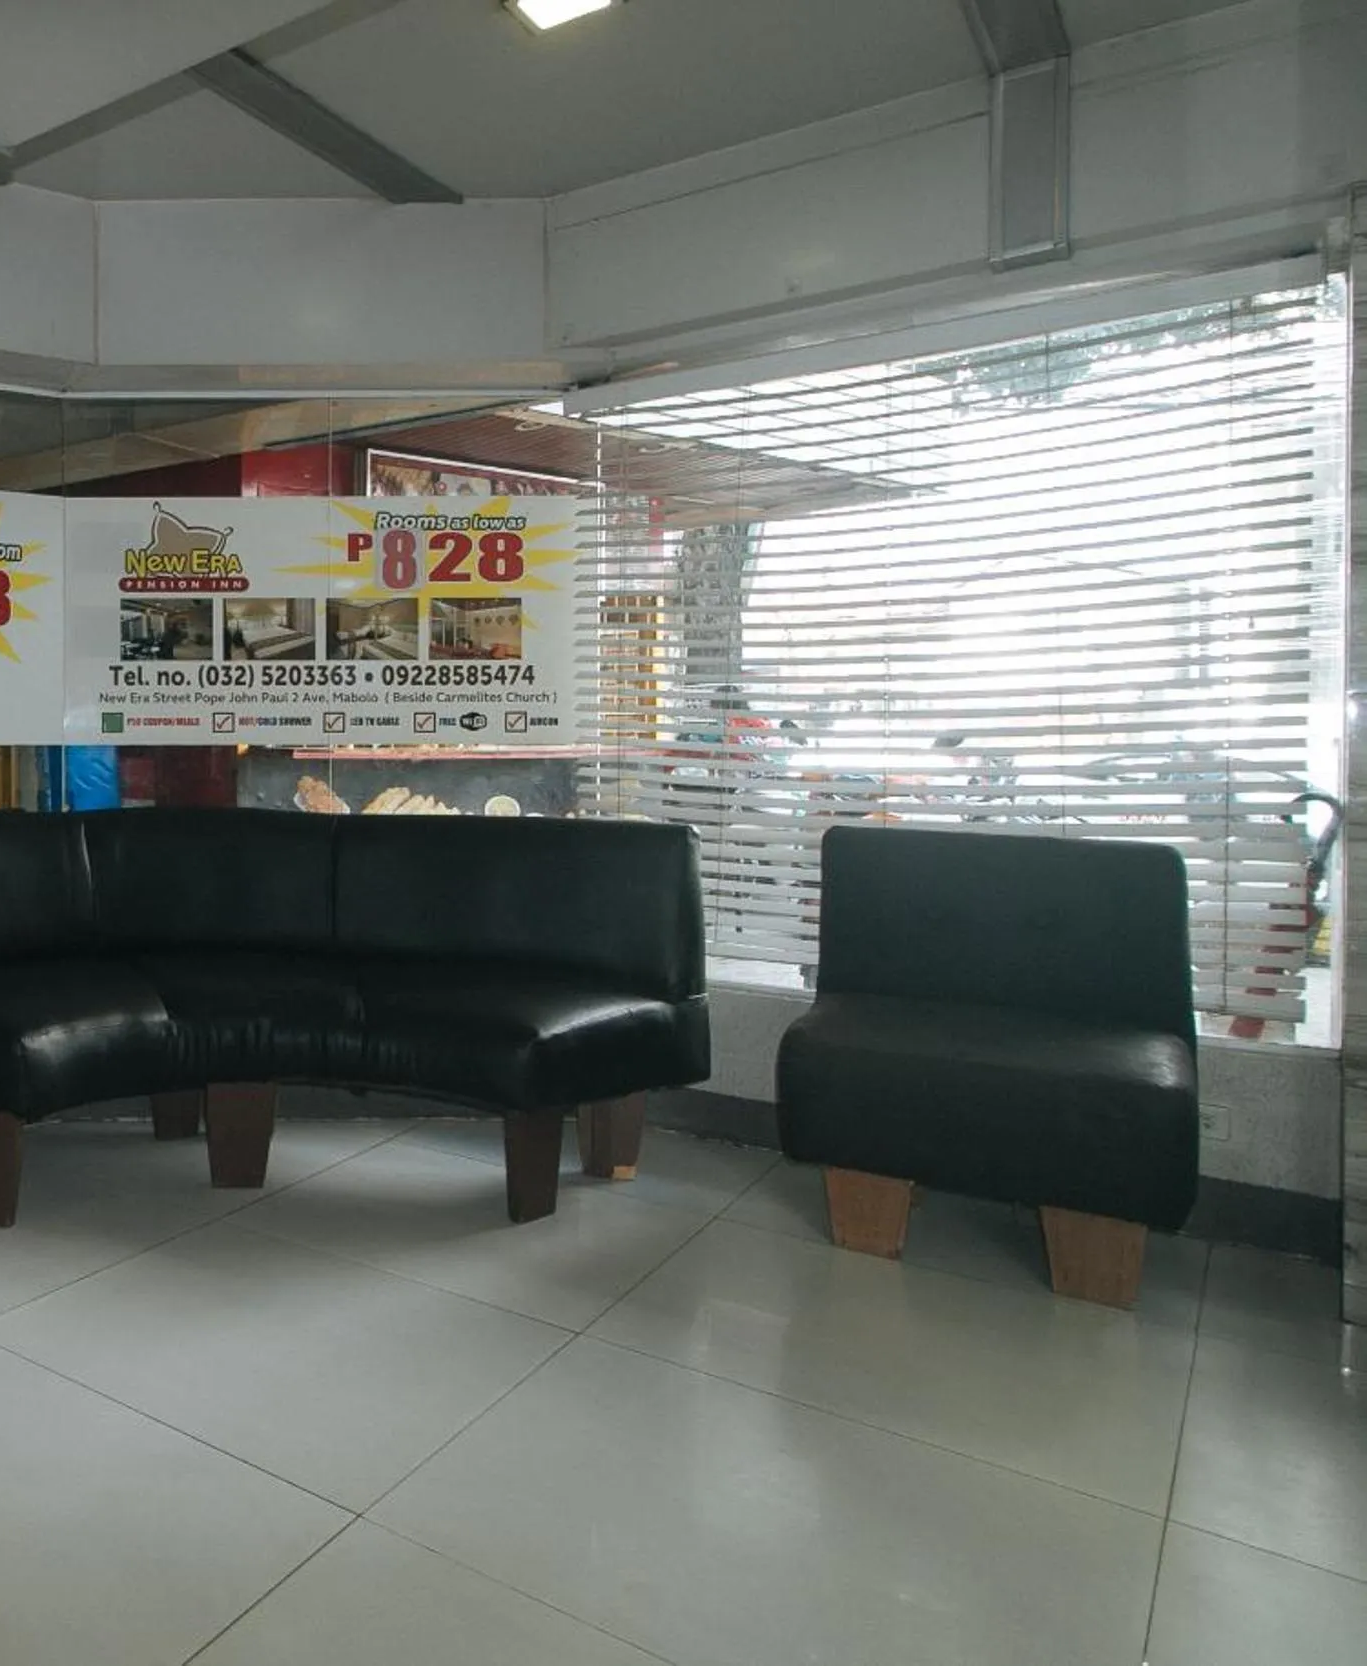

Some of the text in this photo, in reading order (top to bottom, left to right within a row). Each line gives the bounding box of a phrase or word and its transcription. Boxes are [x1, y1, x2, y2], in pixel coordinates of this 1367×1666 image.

[374, 511, 527, 531] Rooms as low as
[125, 549, 242, 577] New ERA
[126, 580, 242, 589] PENSION INN
[109, 665, 535, 688] Tel. no. (032) 5203363 09228585474
[99, 693, 127, 704] New
[131, 693, 150, 704] Era
[152, 692, 191, 704] Street
[195, 692, 226, 706] Pope
[229, 691, 258, 704] John
[262, 691, 288, 704] Paul
[292, 692, 299, 704] 2
[436, 691, 502, 704] Carmelites
